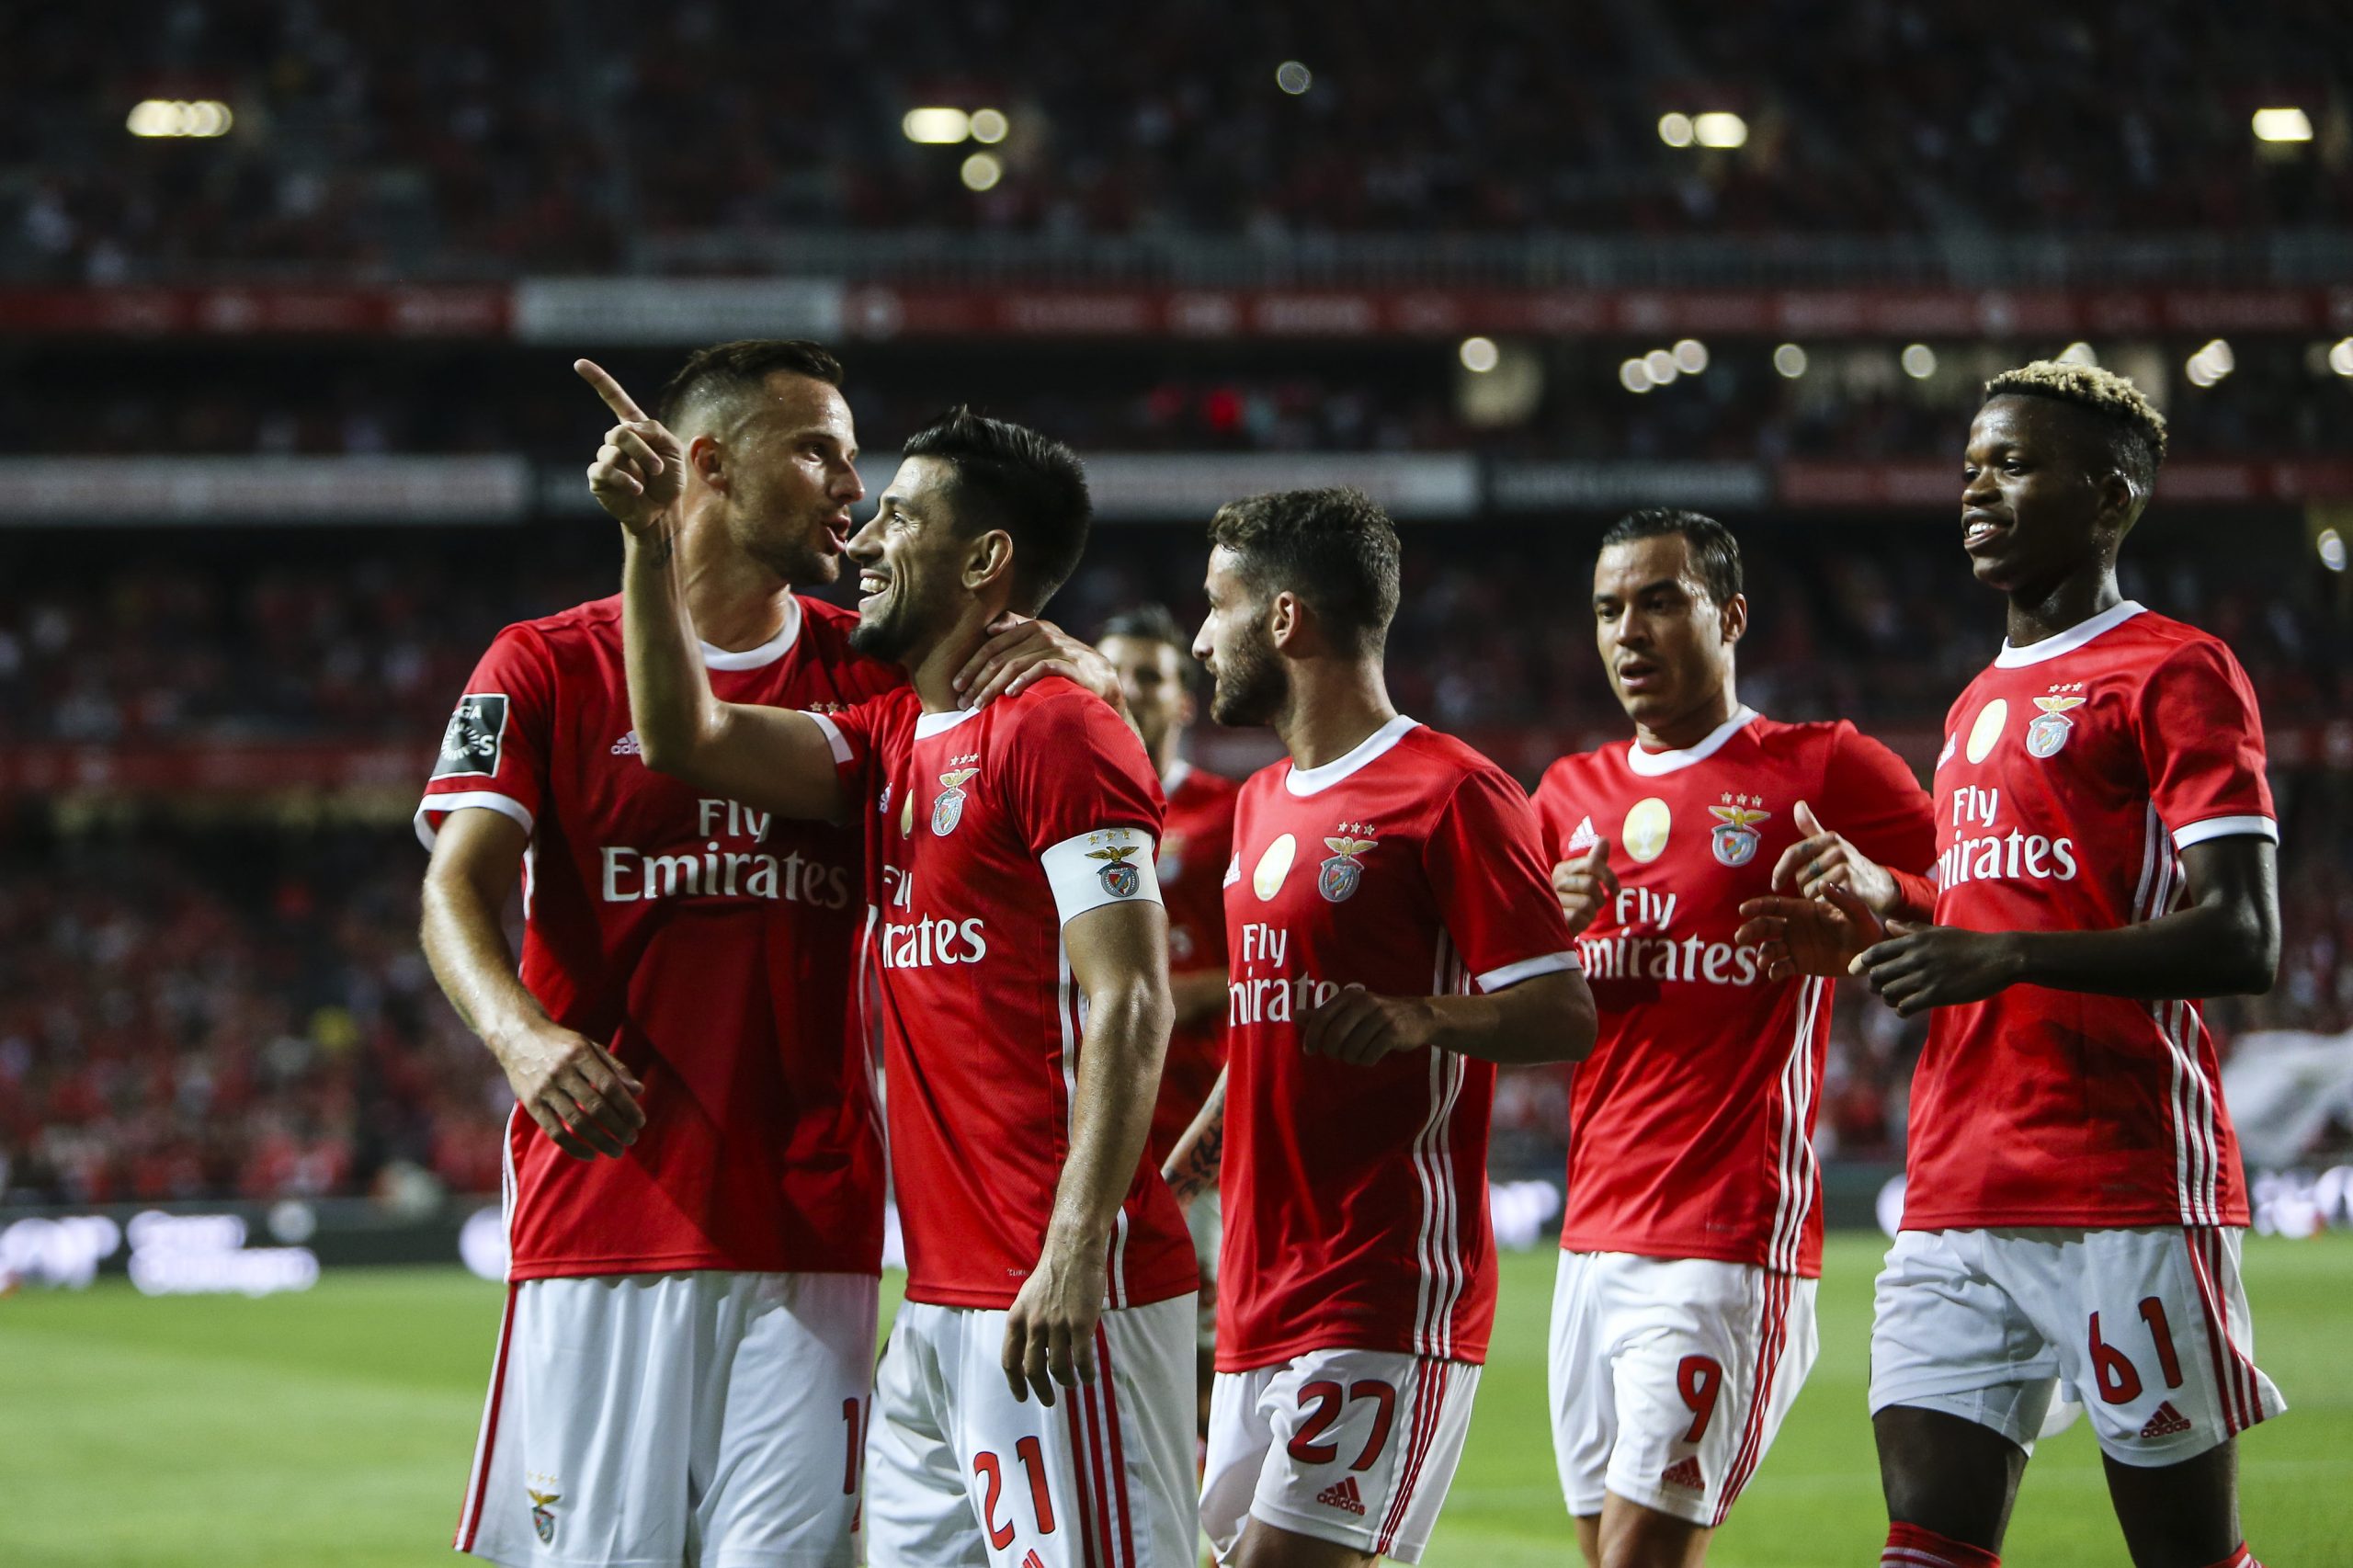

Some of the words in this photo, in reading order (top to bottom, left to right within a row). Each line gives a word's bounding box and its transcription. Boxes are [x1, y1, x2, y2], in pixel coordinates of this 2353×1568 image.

[698, 799, 771, 843] Fly
[1952, 785, 1998, 827] Fly
[599, 841, 848, 910] Emirates
[1938, 826, 2077, 895] mirates
[1616, 886, 1677, 930] Fly
[1243, 922, 1287, 968] Fly
[1574, 926, 1756, 986] mirates
[2088, 1296, 2184, 1405] 61
[1288, 1380, 1396, 1471] 27
[1677, 1355, 1722, 1442] 9
[2141, 1419, 2191, 1438] adidas
[843, 1395, 870, 1495] 1
[973, 1436, 1056, 1551] 21
[1317, 1493, 1366, 1516] adidas
